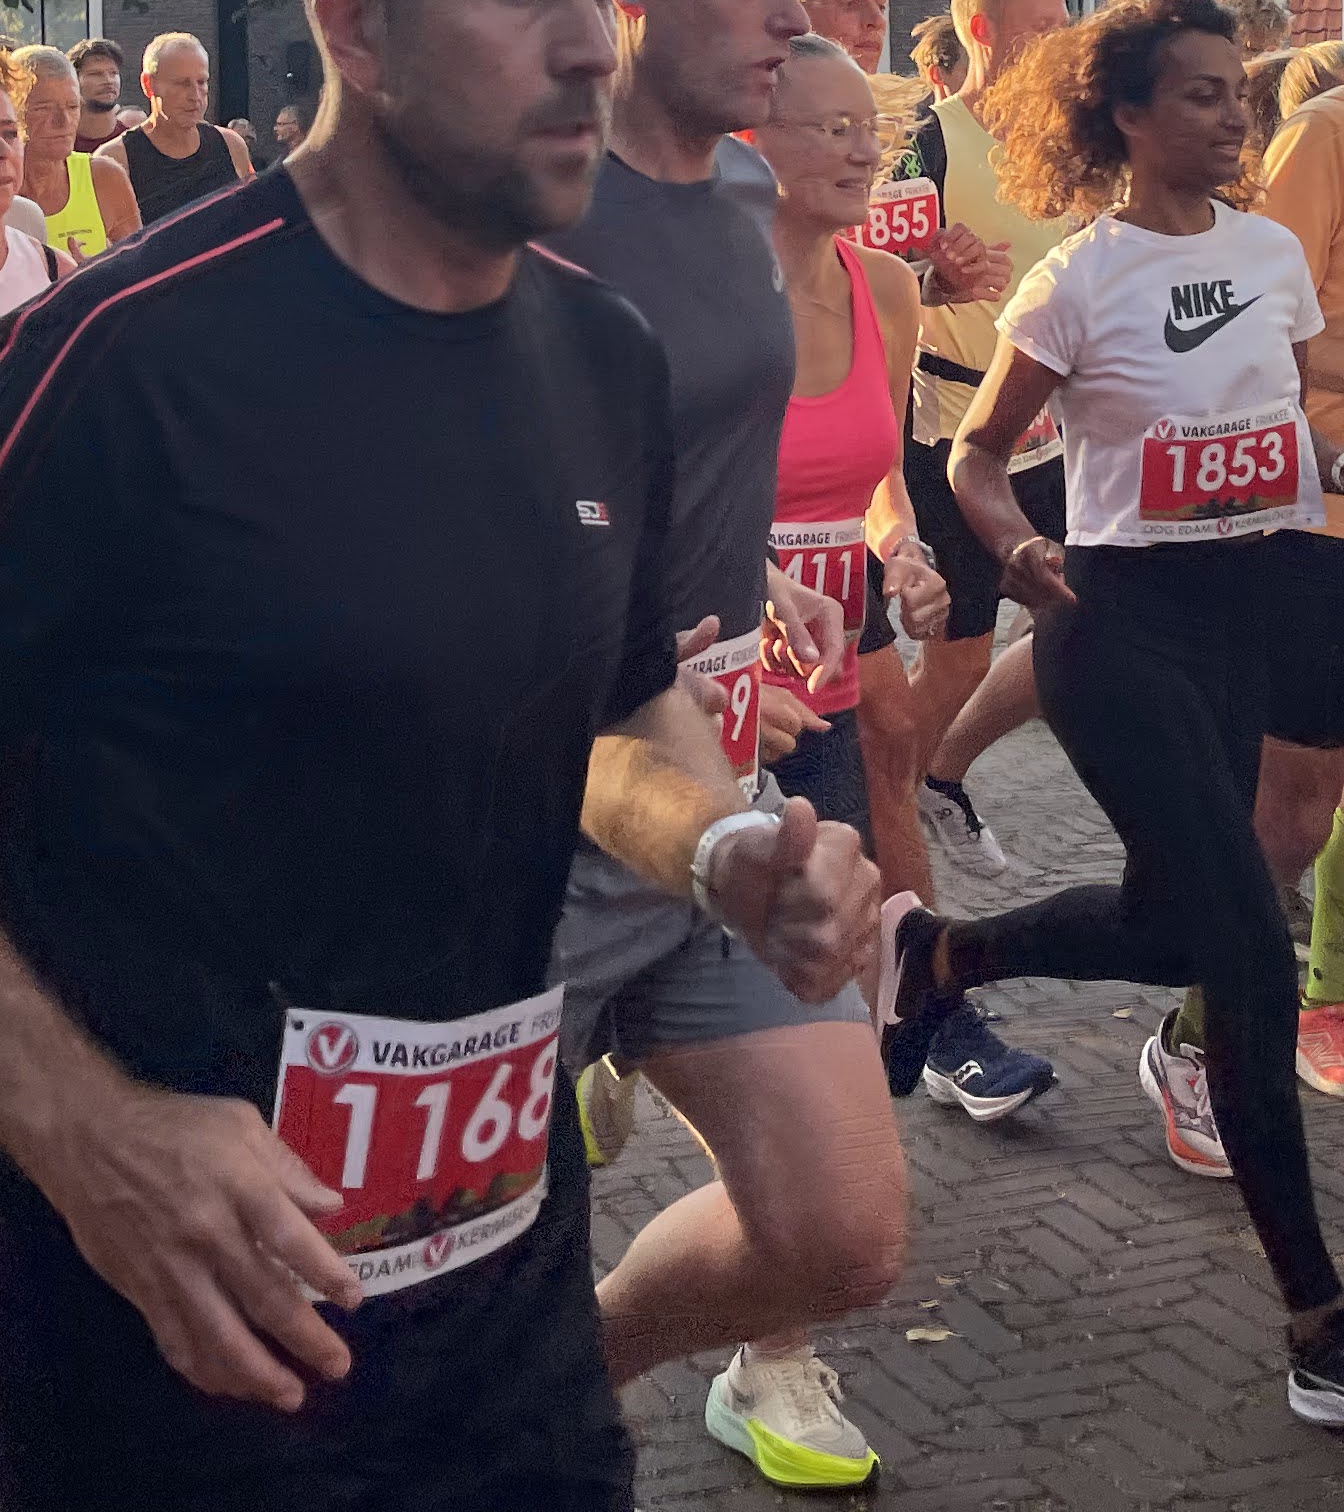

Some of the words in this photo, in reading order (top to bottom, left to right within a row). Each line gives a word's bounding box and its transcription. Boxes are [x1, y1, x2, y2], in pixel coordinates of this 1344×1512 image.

[1171, 279, 1240, 321] NIKE
[1181, 418, 1251, 438] VAKGARAGE
[1166, 432, 1286, 493] 1853
[372, 1022, 523, 1068] VAKGARAGE
[333, 1036, 559, 1189] 1168
